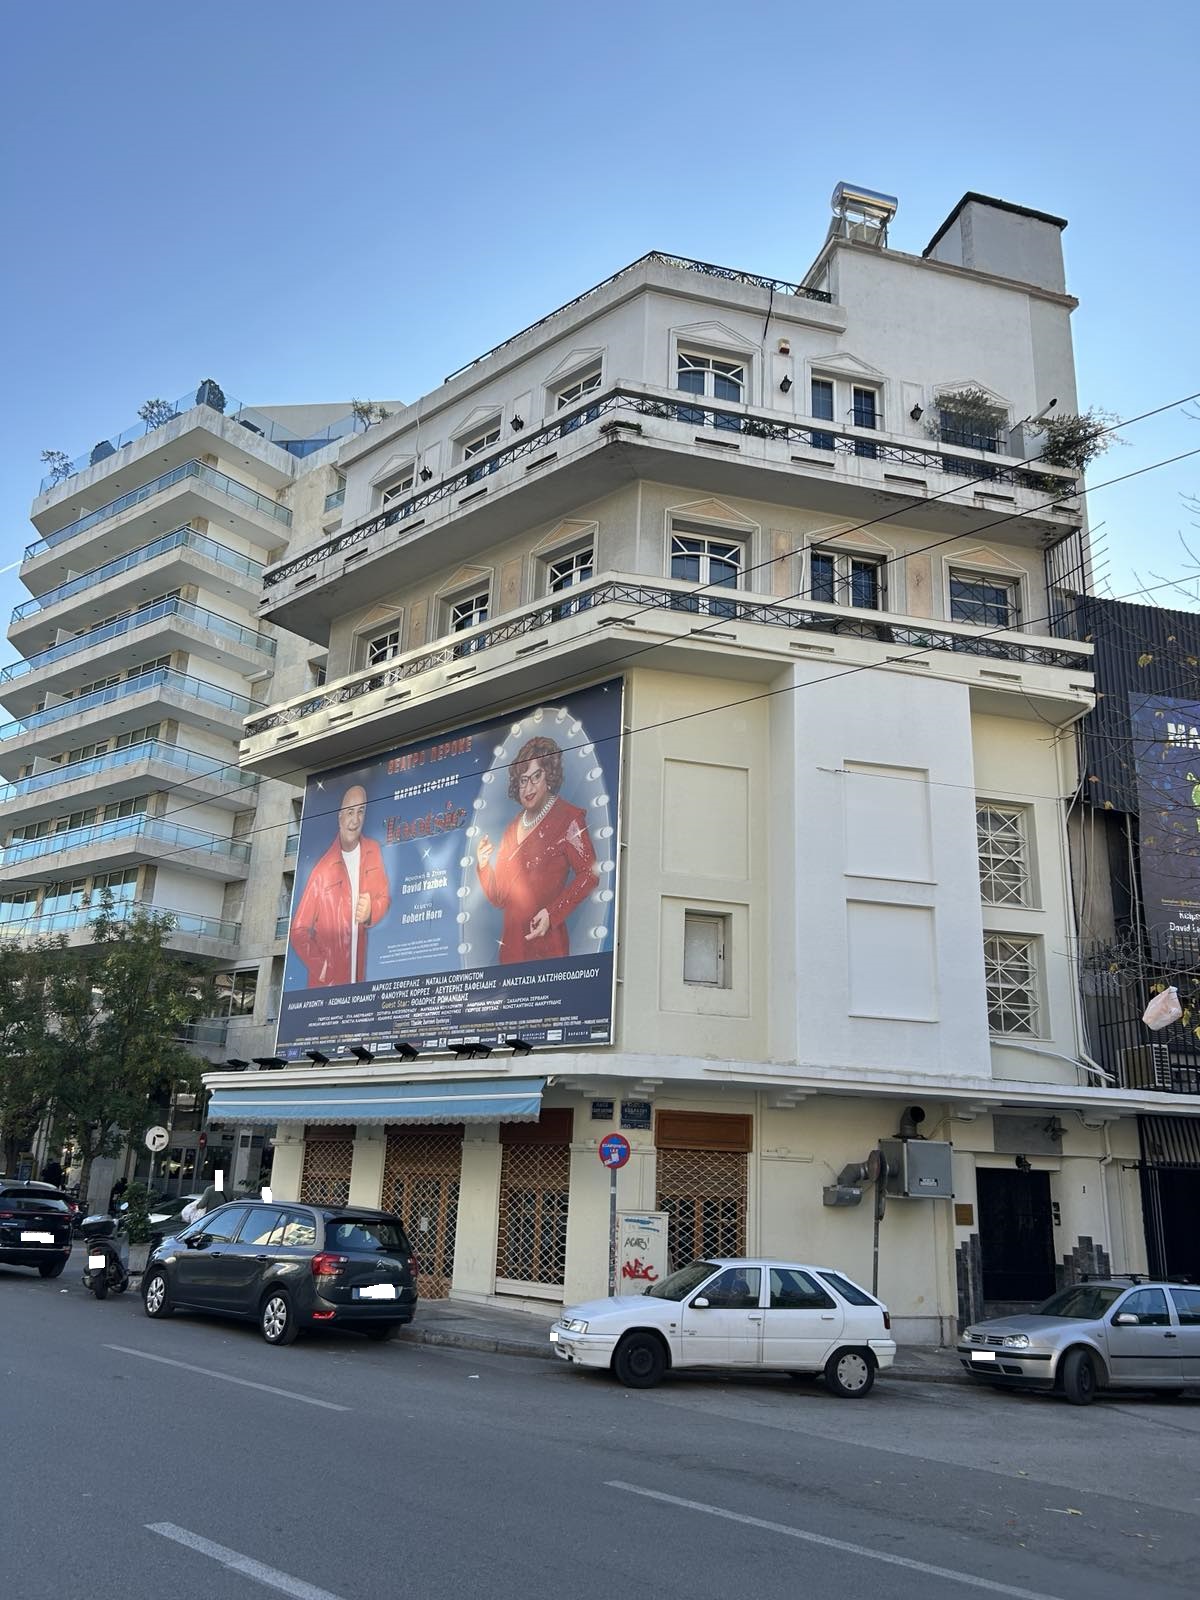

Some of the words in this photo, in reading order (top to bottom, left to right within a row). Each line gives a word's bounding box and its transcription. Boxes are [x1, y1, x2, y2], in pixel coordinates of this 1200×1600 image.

[387, 750, 425, 775] ΘΕΑΤΡΟ
[394, 784, 422, 800] ΜΑΡΚΟΣ
[402, 881, 422, 895] David
[422, 876, 448, 891] Yazbek
[402, 911, 425, 924] Robert
[425, 909, 442, 920] Horn
[371, 982, 392, 992] ΜΑΡΚΟΣ
[393, 979, 420, 989] ΣΕΦΕΡΛΗΣ
[425, 976, 447, 986] NATALIA
[448, 971, 484, 983] CORVINGTON
[381, 990, 409, 1000] ΦΑΝΟΥΡΗΣ
[409, 987, 430, 997] ΚΟΡΡΕΣ
[435, 983, 464, 994] ΛΕΥΤΕΡΗΣ
[464, 979, 496, 991] ΒΑΦΕΙΑΔΗΣ
[502, 975, 536, 987] ΑΝΑΣΤΑΣΙΑ
[537, 968, 600, 984] ΧΑΤΖΗΘΕΟΔΩΡΙΔΟΥ
[437, 993, 469, 1004] ΡΩΜΑΝΙΔΗΣ
